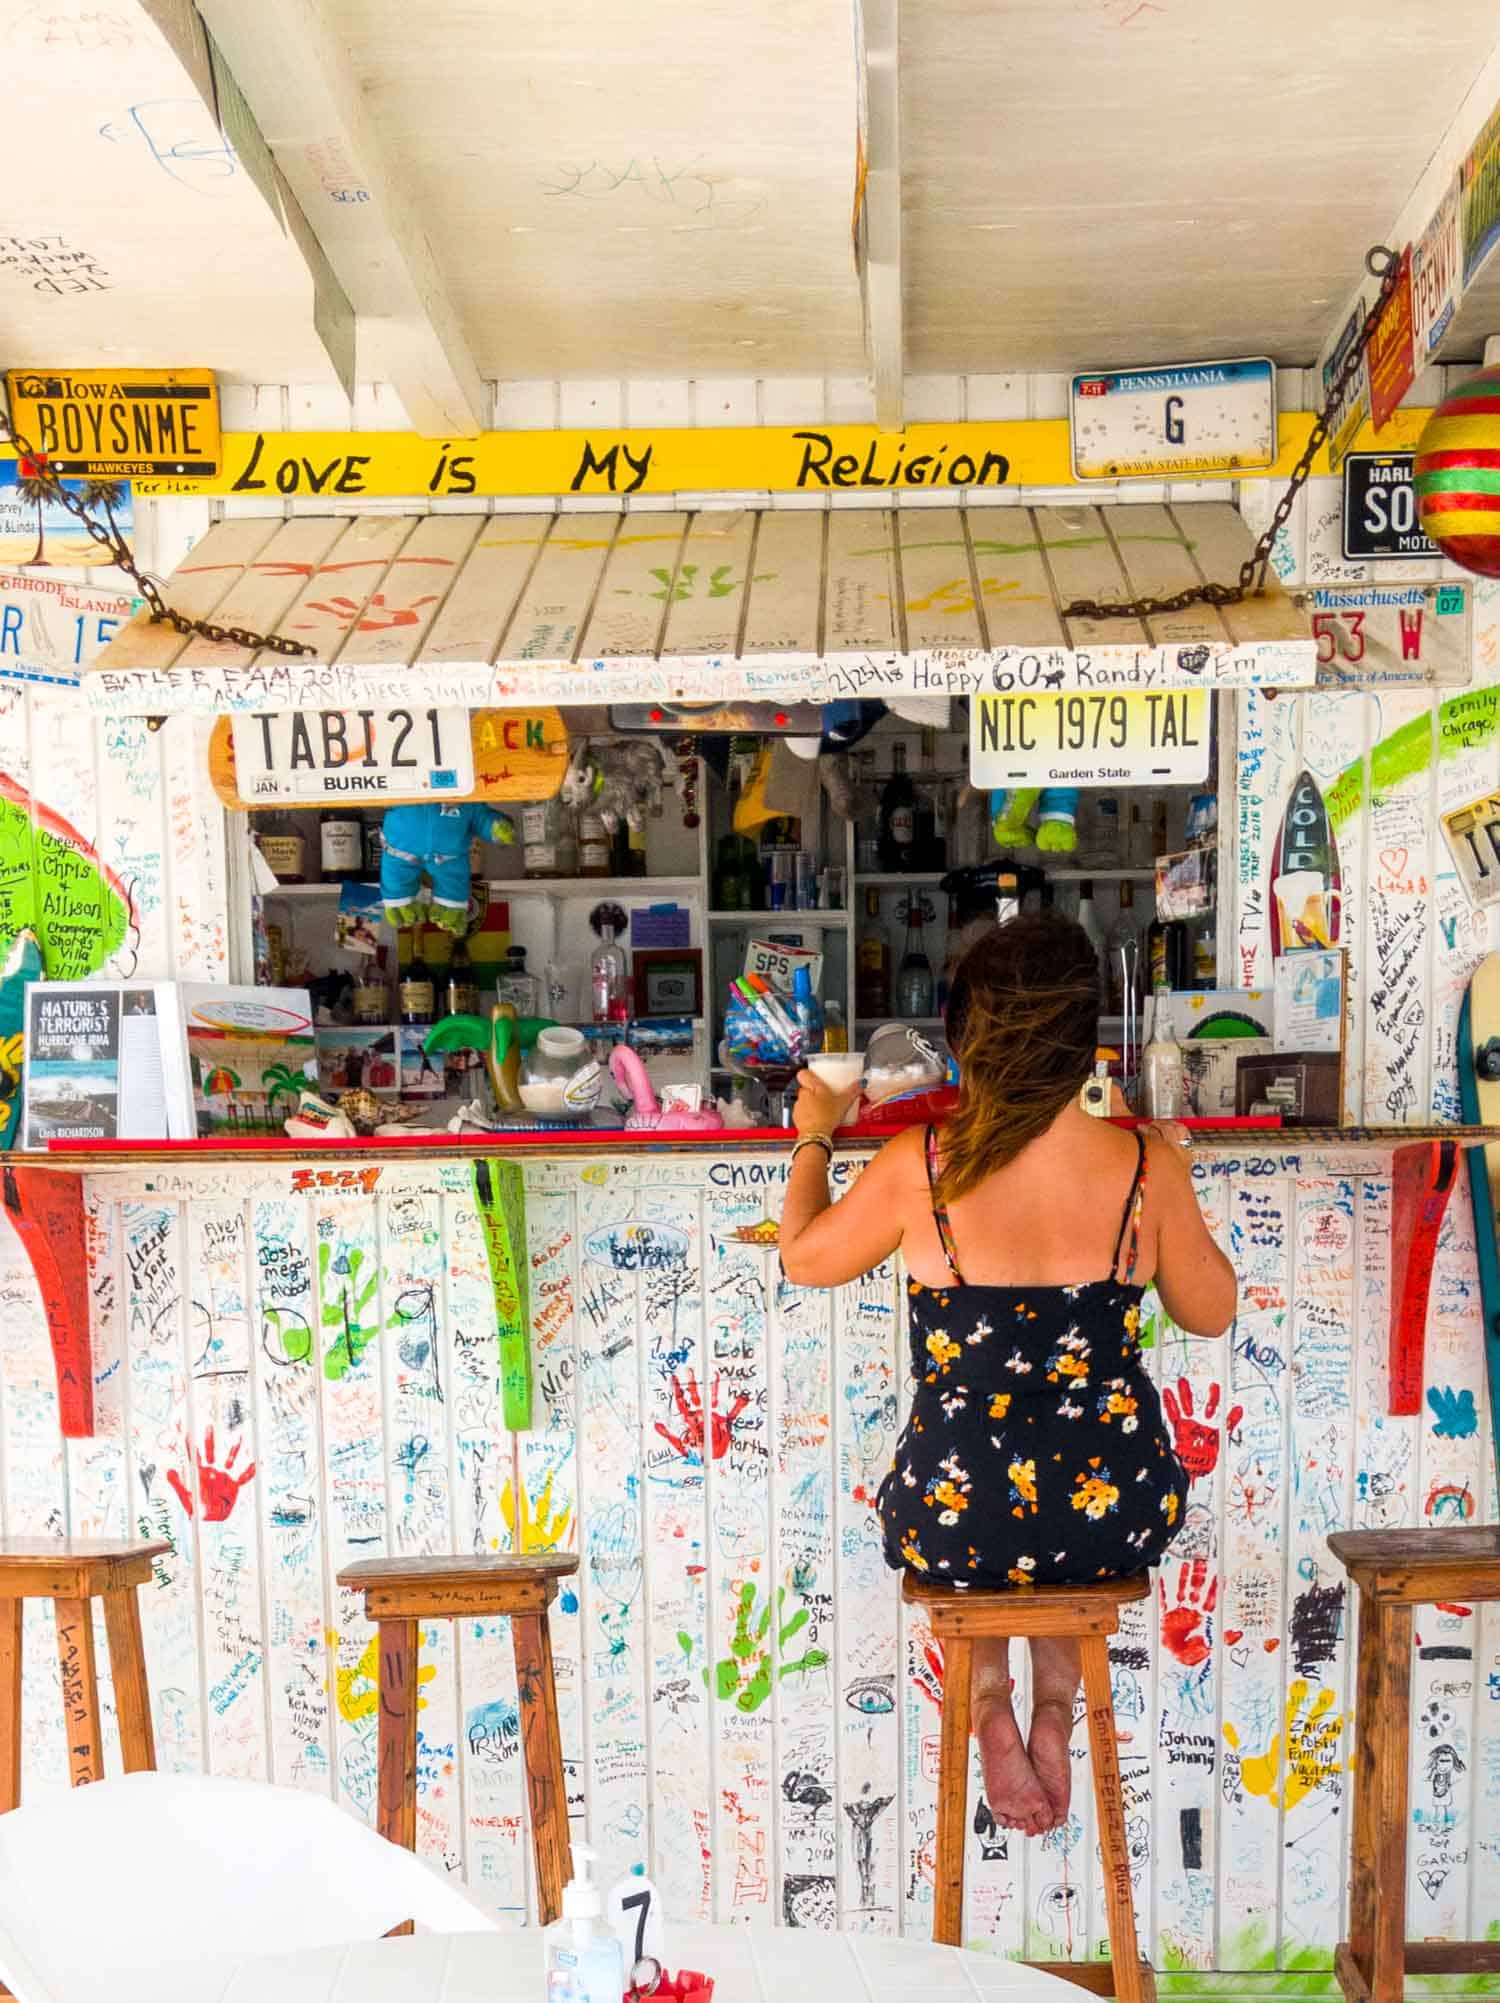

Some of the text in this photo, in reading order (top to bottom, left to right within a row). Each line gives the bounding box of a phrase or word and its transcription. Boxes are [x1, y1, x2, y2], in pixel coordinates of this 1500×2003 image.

[1119, 369, 1226, 391] PENNSYLVANIA
[64, 382, 125, 402] IOWA
[38, 402, 204, 457] BOYSNME
[1165, 395, 1186, 445] G
[87, 462, 155, 476] HAWKEYES
[231, 433, 371, 495] LOVE
[429, 442, 477, 494] is
[570, 439, 657, 494] MY
[11, 577, 66, 597] RHODE
[59, 595, 119, 614] ISLAND
[1313, 589, 1426, 608] Massachusetts
[1440, 597, 1460, 612] 07
[1399, 607, 1424, 661] W
[912, 656, 985, 692] Happy
[1076, 654, 1168, 687] Randy!
[1379, 670, 1424, 682] America
[980, 693, 1199, 752] NIC 1979 TAL
[251, 708, 444, 772] TABI21
[323, 775, 389, 791] BURKE
[1049, 767, 1132, 780] Garden State
[255, 781, 279, 794] JAN
[41, 855, 92, 879] Chris
[43, 891, 102, 920] Allison
[755, 952, 790, 976] SPS
[40, 1000, 109, 1018] NATURE'S
[39, 1016, 111, 1034] TERRORIST
[38, 1034, 110, 1047] HURRICANE IRMA
[57, 1127, 105, 1138] RICHARDSON
[290, 1166, 384, 1195] IZZY
[258, 1241, 302, 1266] Josh
[1166, 1749, 1216, 1776] Johnny
[621, 1890, 651, 1963] 7
